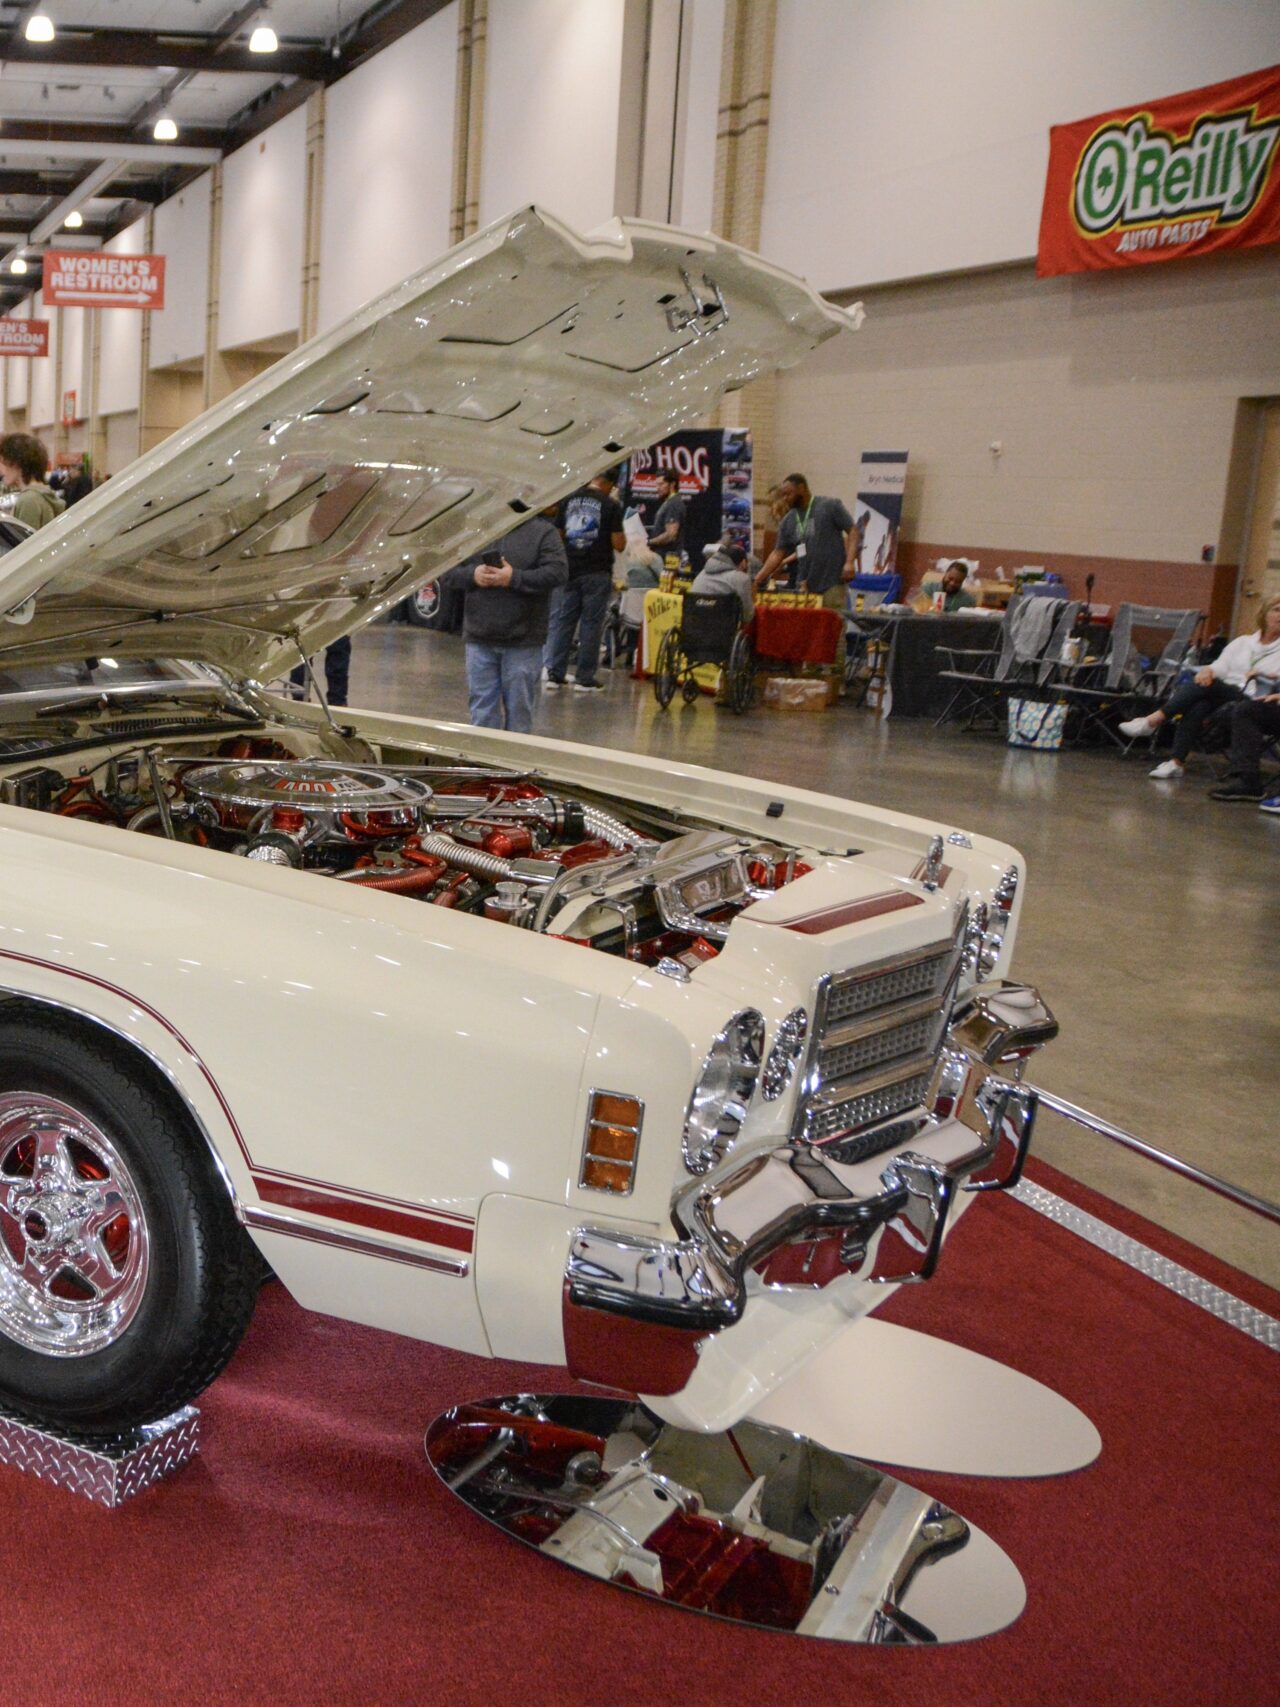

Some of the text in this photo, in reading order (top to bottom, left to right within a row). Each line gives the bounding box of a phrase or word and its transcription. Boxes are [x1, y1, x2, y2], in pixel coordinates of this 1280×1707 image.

[1078, 116, 1276, 230] O'Reilly
[1116, 218, 1214, 253] AUTO PARTS
[50, 271, 158, 292] RESTROOM
[59, 256, 150, 275] WOMEN'S
[656, 445, 709, 488] HOG
